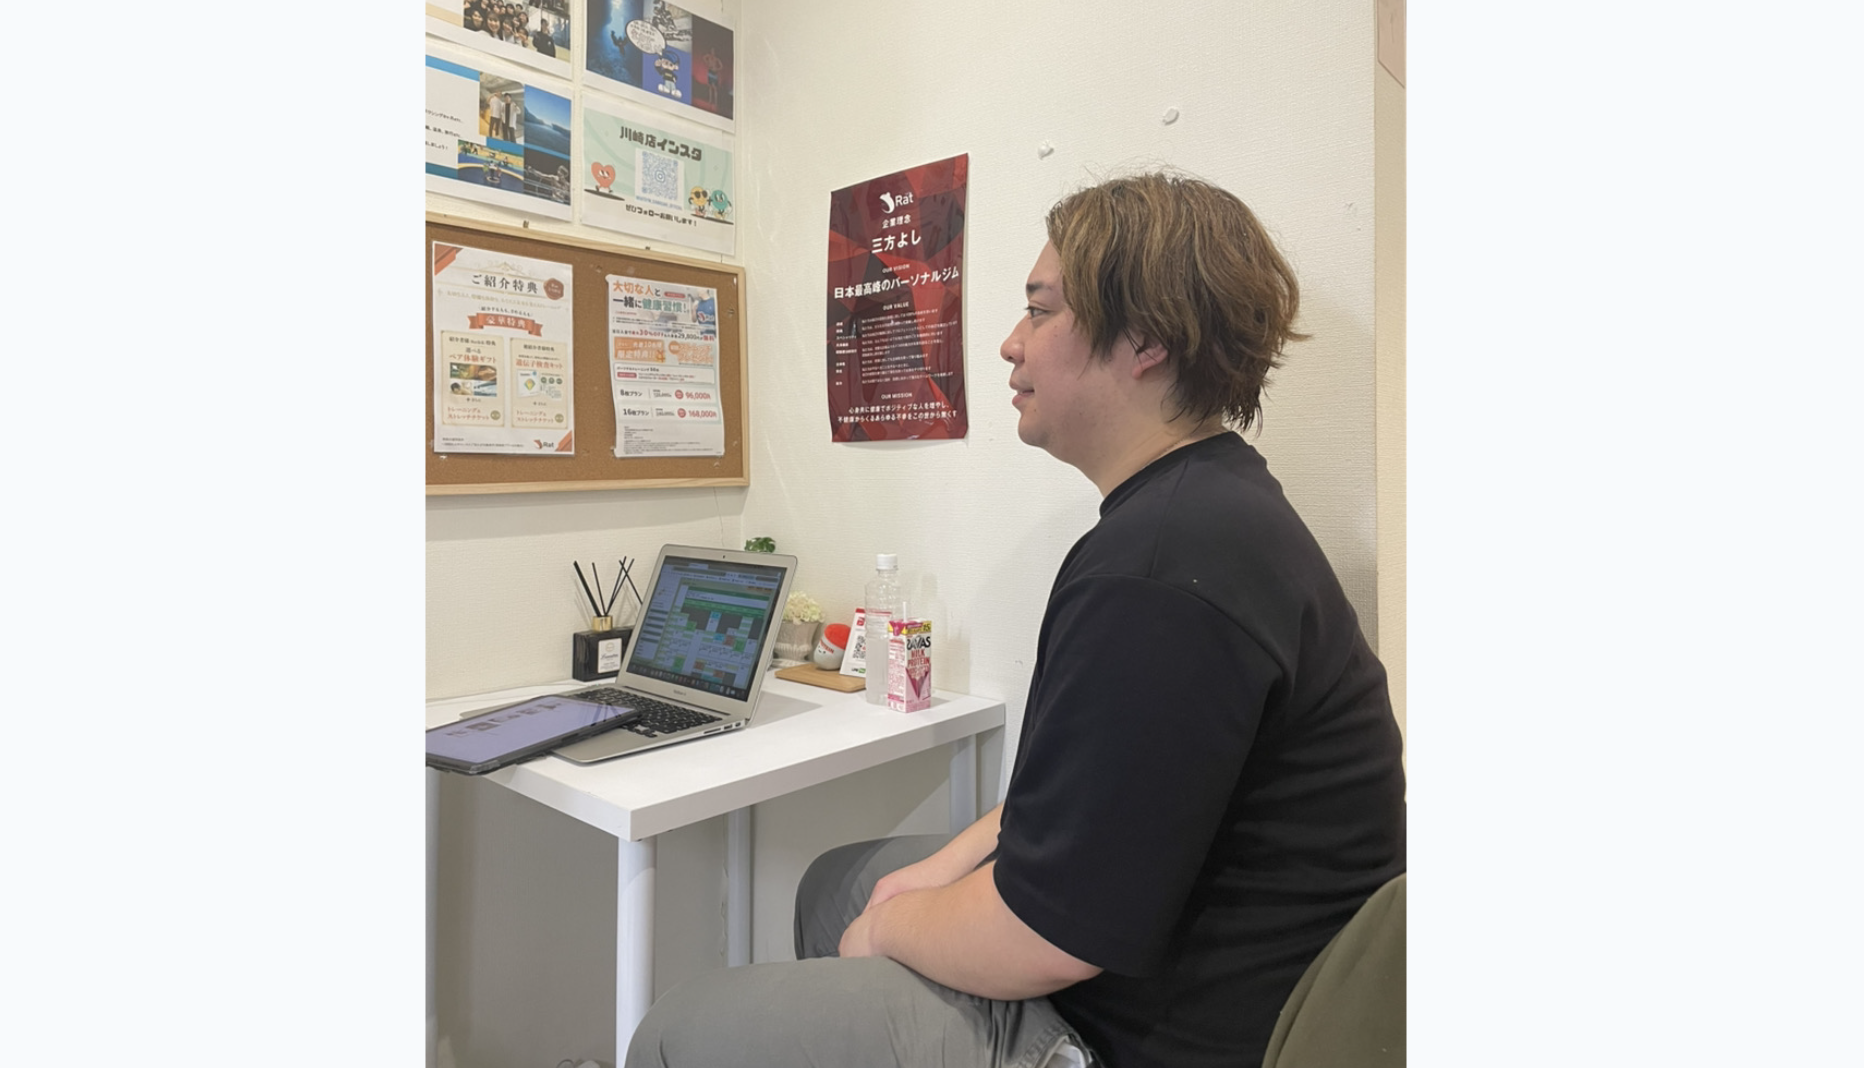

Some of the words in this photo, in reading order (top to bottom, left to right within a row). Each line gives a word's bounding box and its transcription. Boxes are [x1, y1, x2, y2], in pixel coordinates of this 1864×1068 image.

[620, 126, 702, 161] 川崎店インスタ
[896, 193, 914, 205] Rat
[882, 214, 911, 228] 企業理念
[872, 230, 921, 253] 三方よし
[472, 274, 538, 294] ご紹介特典
[613, 280, 661, 296] 大切な人と
[834, 266, 959, 298] 日本最高峰のパーソナルジム
[486, 317, 526, 328] 豪華特典
[449, 354, 496, 363] ペア体験ギフト
[911, 650, 925, 658] MILK
[908, 658, 930, 666] PROTEIN
